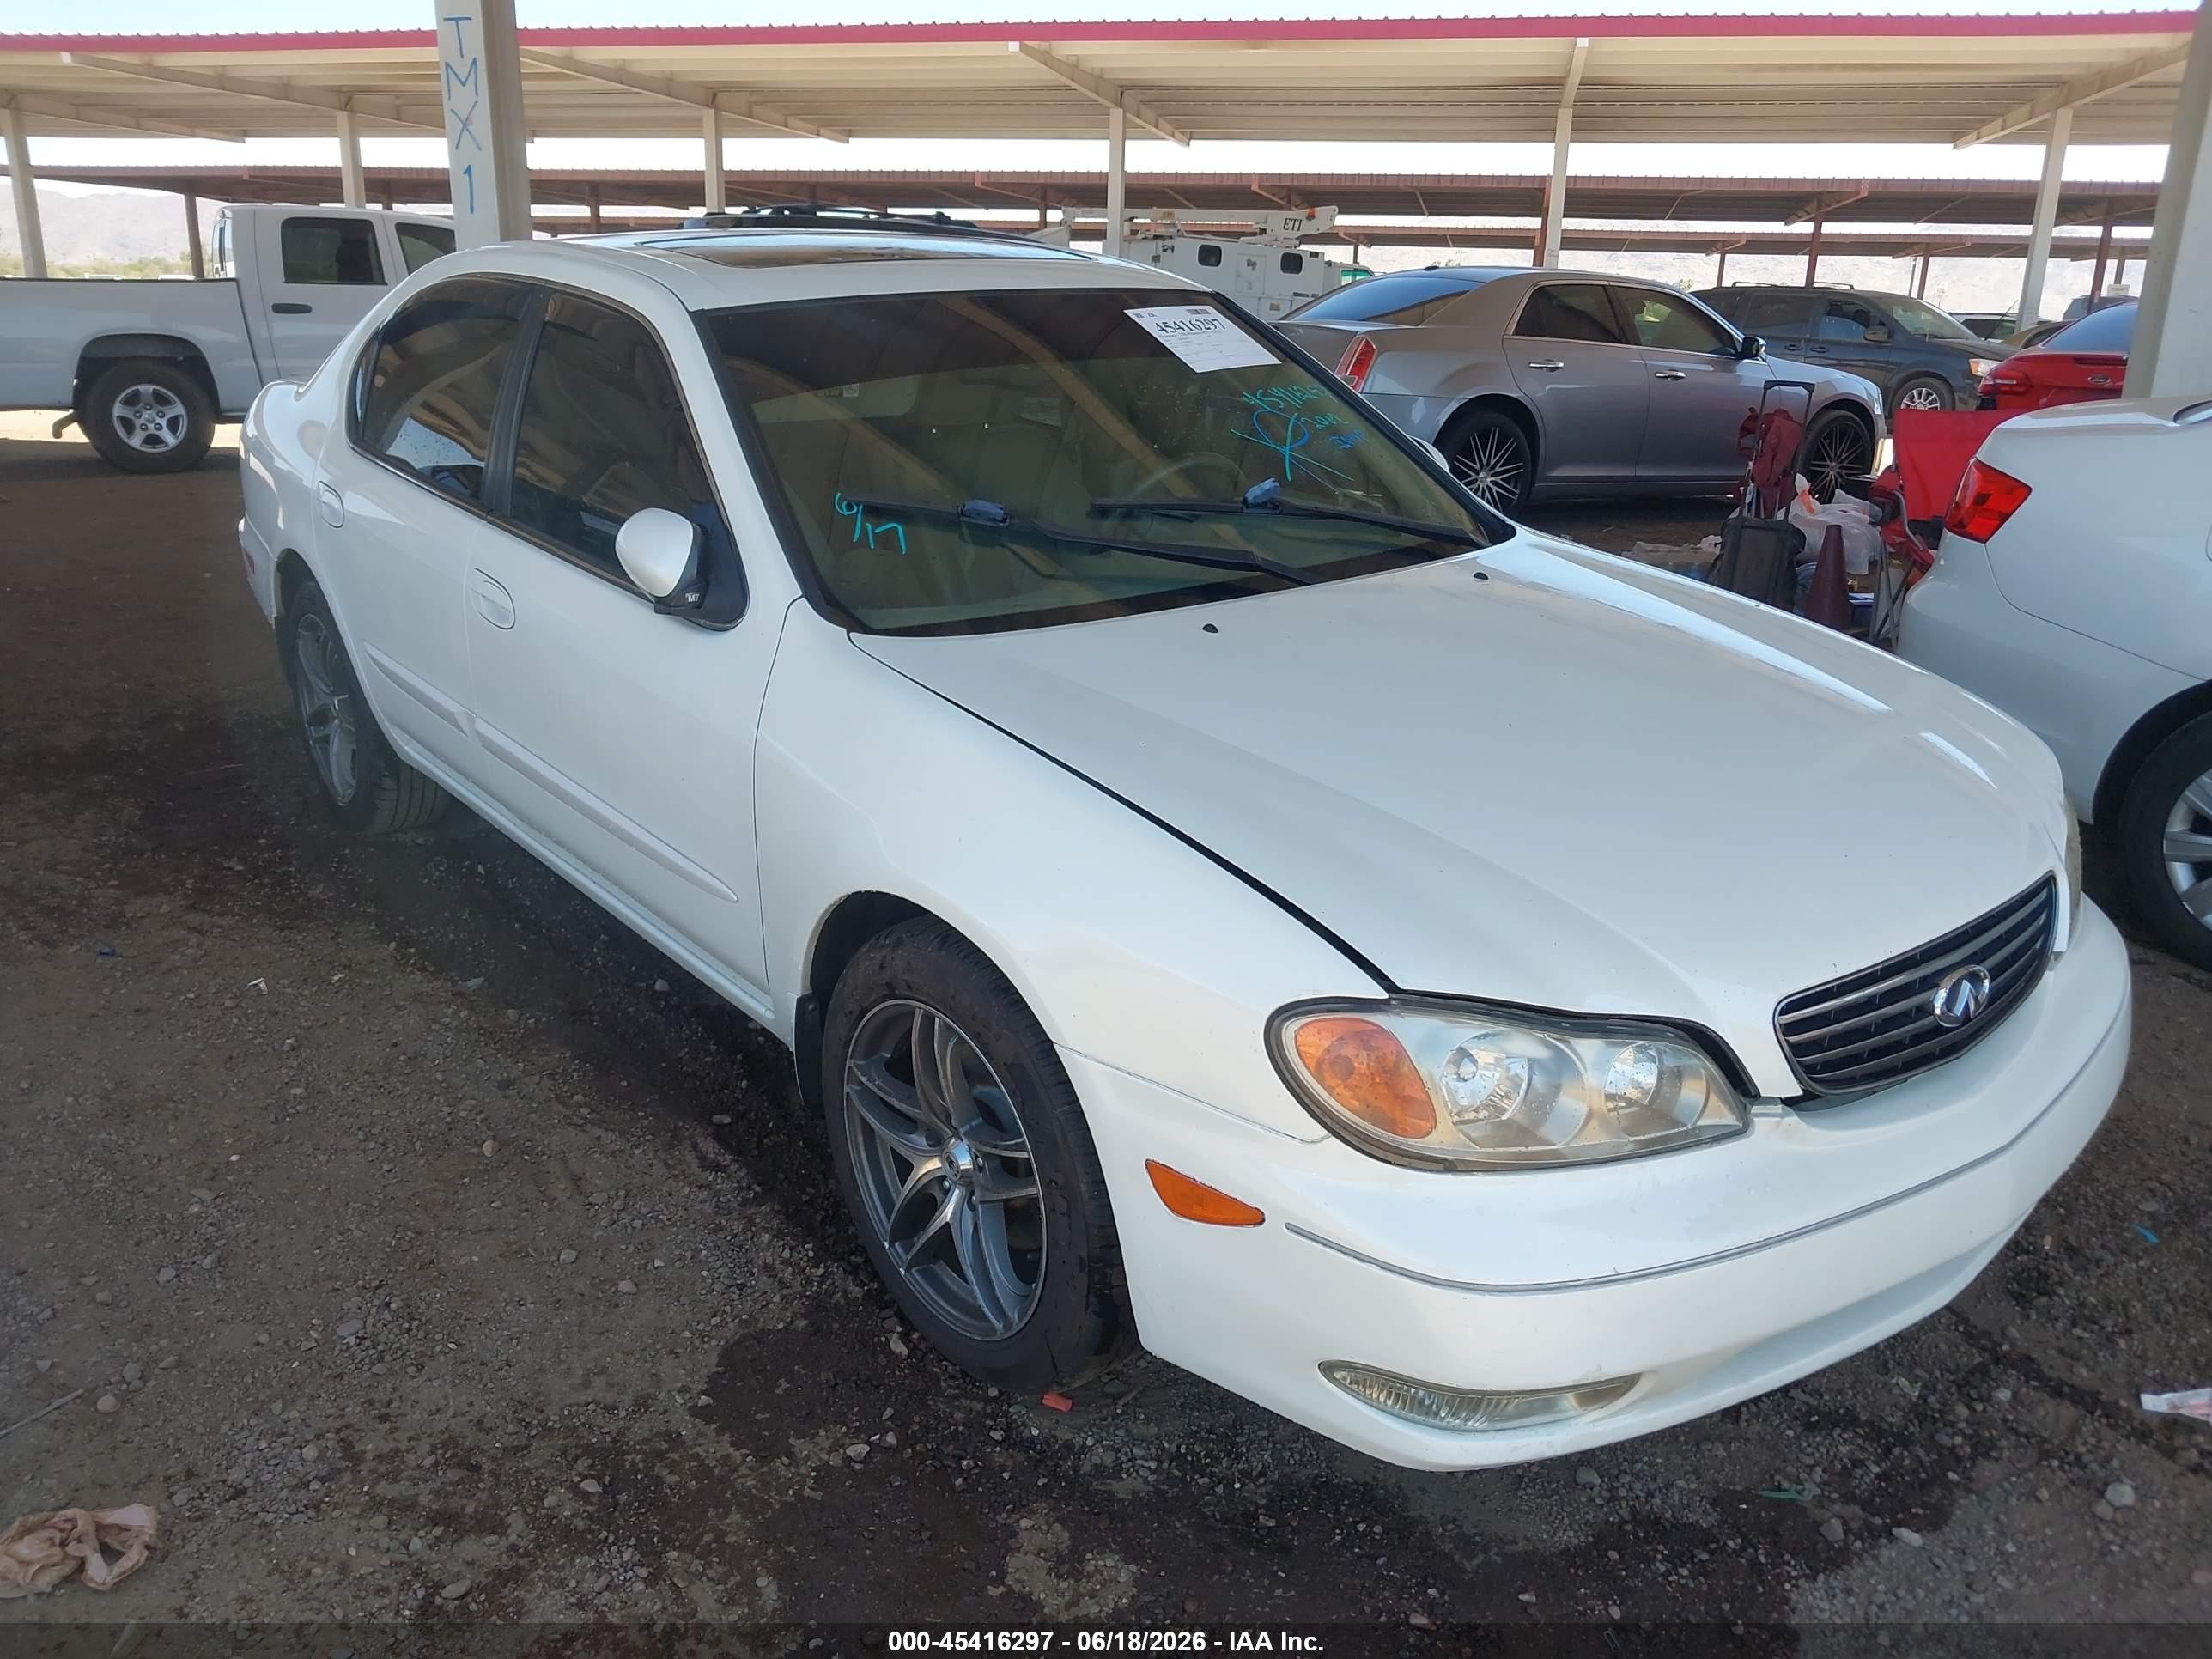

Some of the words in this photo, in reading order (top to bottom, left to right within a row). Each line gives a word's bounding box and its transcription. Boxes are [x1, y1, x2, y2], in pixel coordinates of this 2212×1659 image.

[442, 16, 483, 151] TMX
[462, 163, 474, 215] 1
[1283, 217, 1303, 232] ETI
[1155, 318, 1226, 335] 45416297
[835, 492, 907, 556] 6/17
